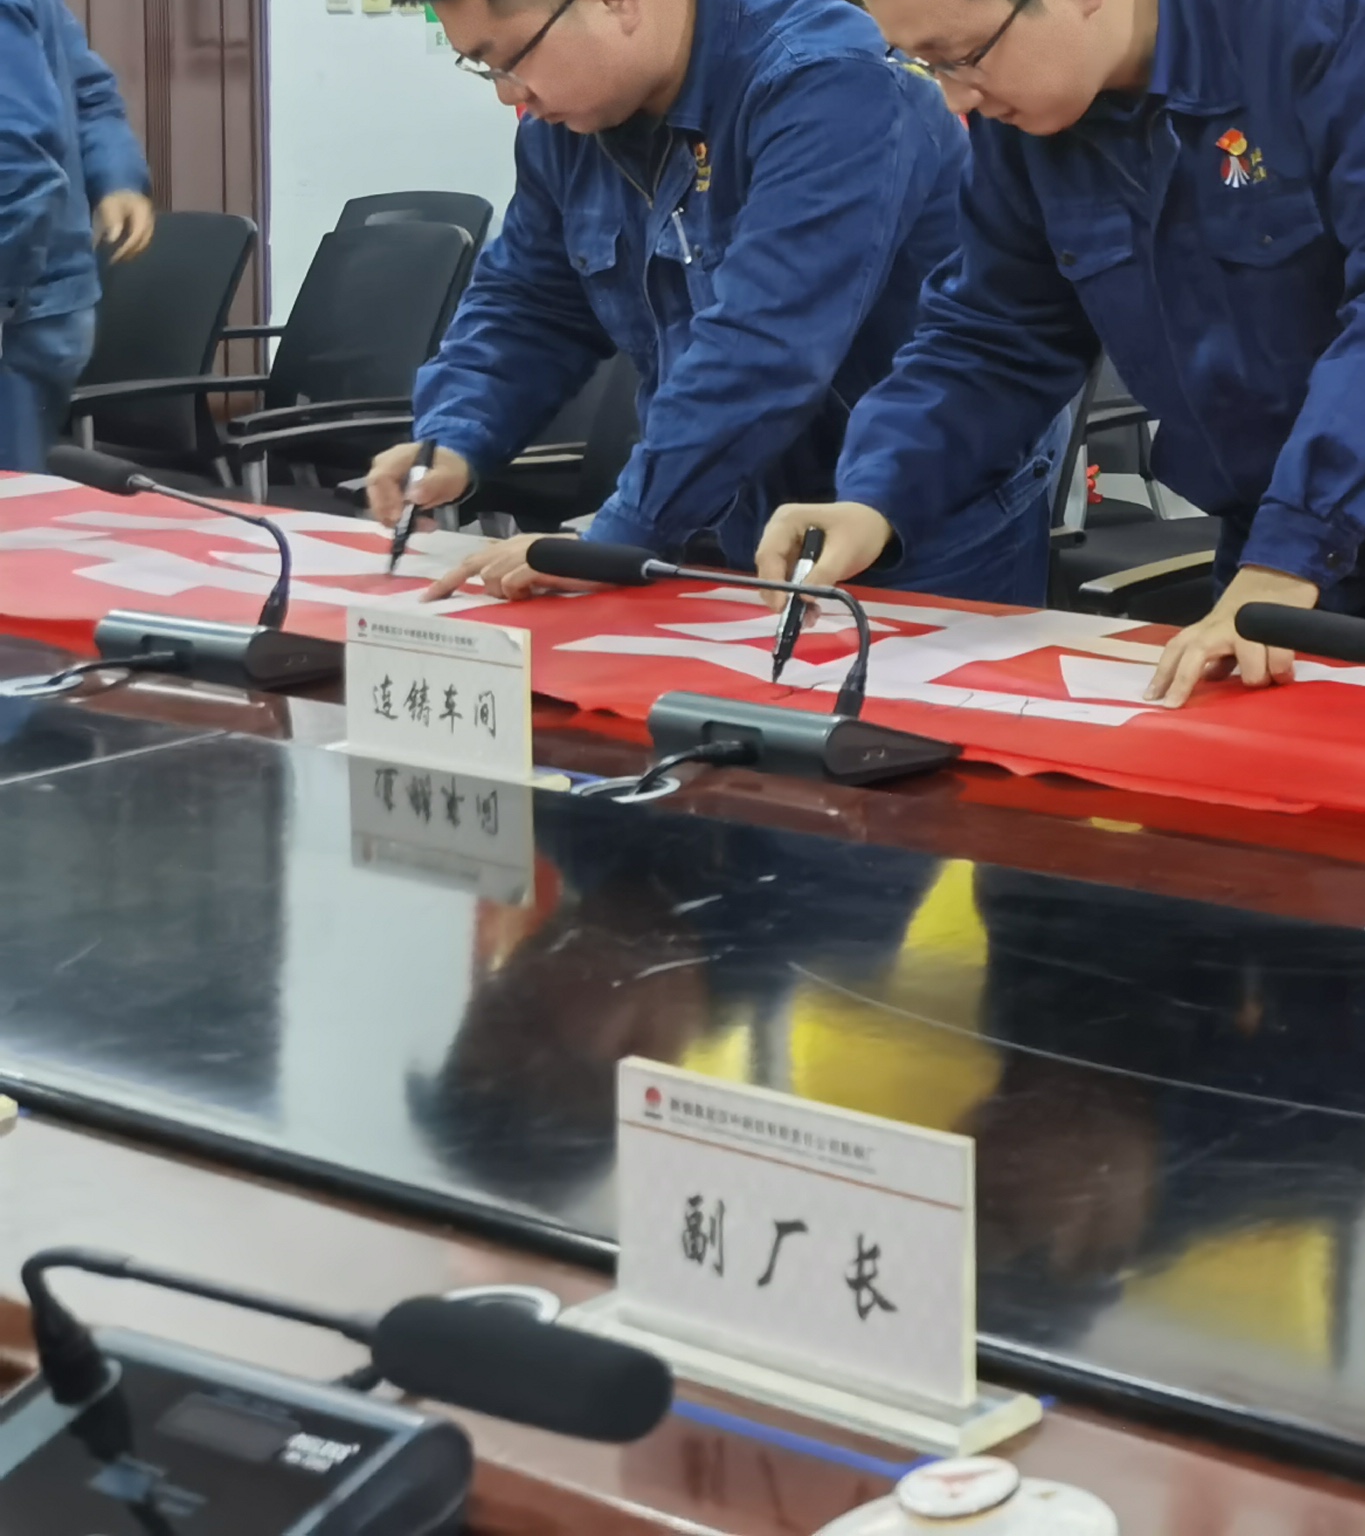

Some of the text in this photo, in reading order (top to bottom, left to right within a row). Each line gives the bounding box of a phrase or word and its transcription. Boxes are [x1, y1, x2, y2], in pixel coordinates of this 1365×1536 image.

[373, 674, 496, 739] 连铸车间
[682, 1195, 898, 1321] 副厂长
